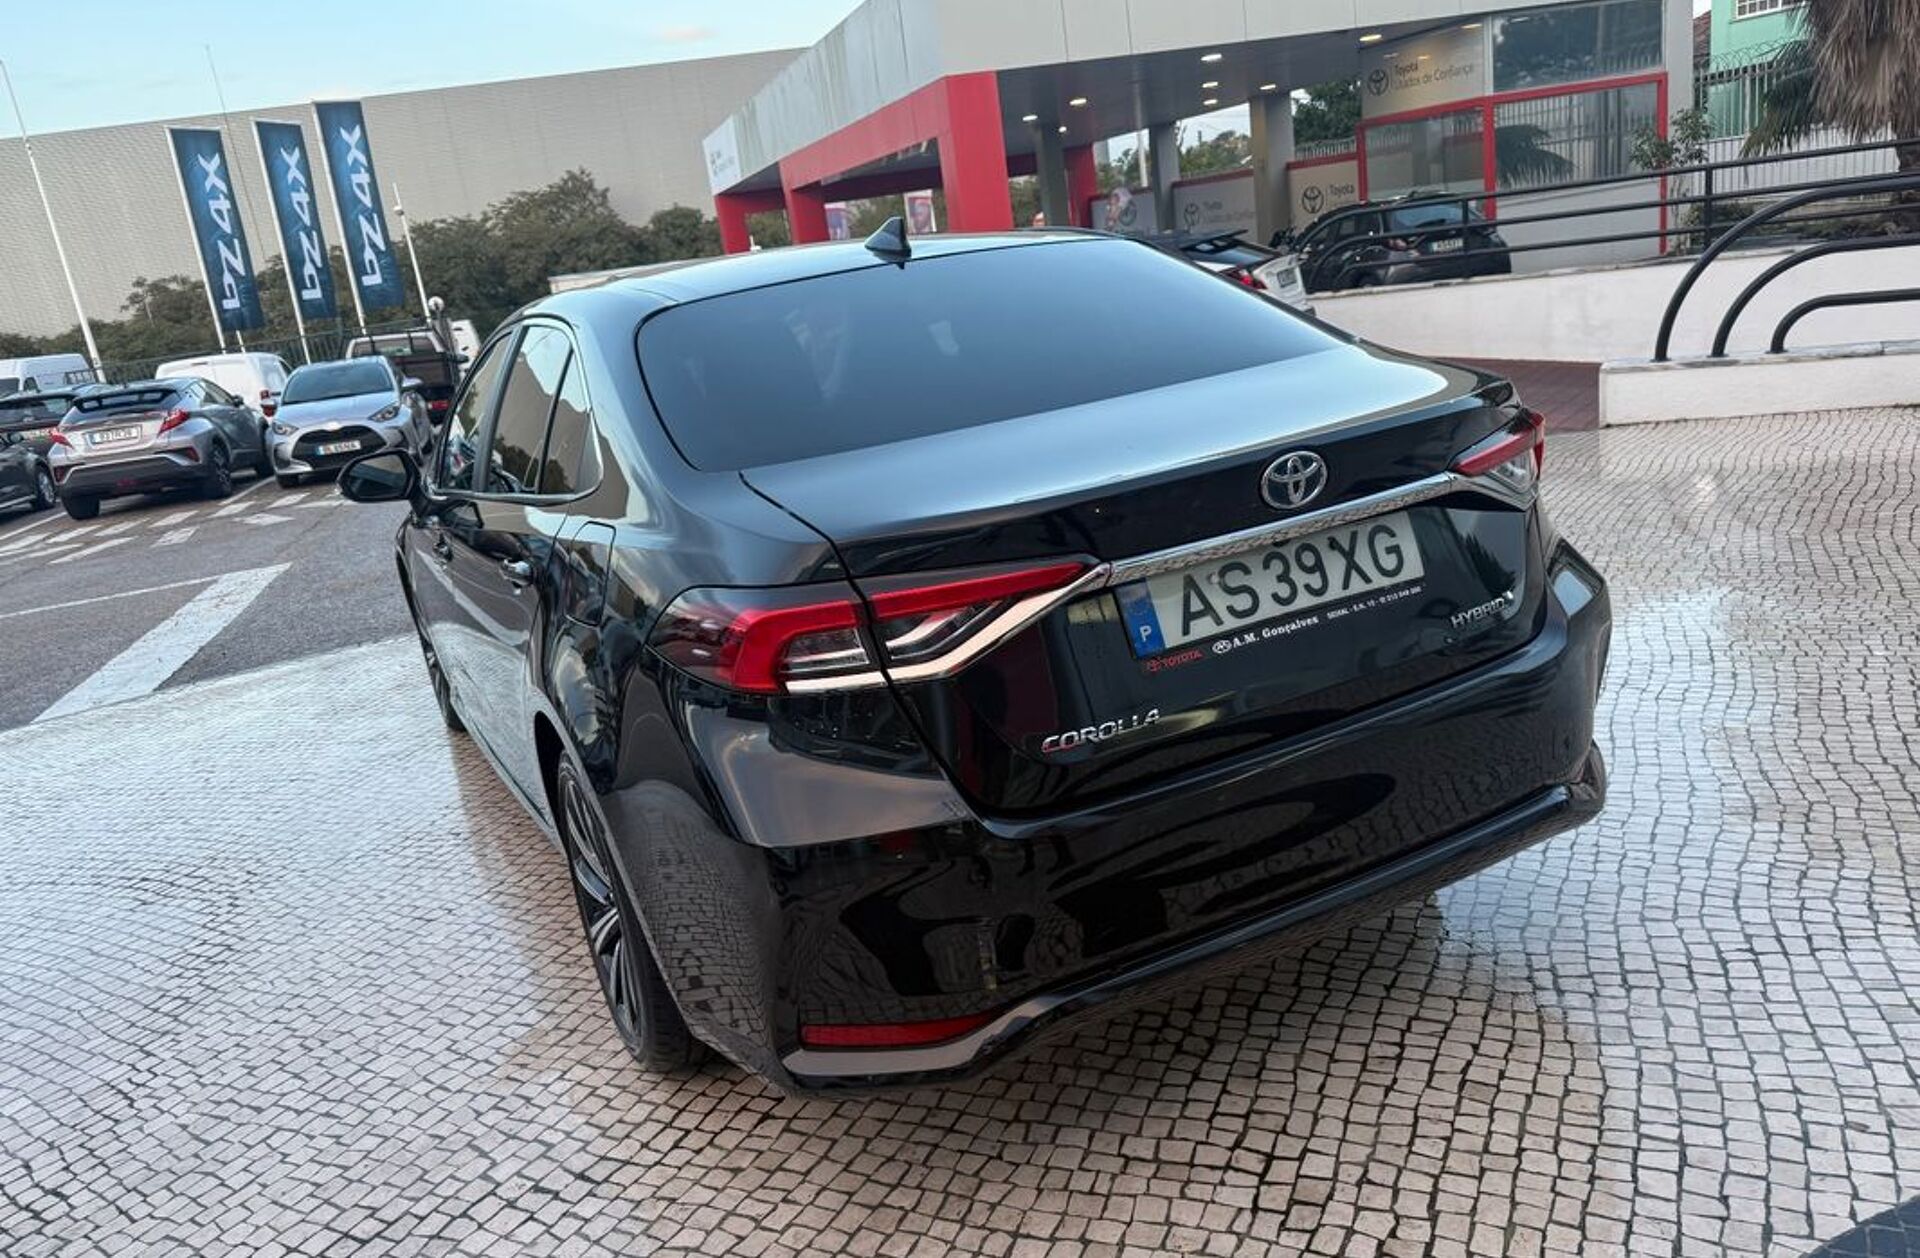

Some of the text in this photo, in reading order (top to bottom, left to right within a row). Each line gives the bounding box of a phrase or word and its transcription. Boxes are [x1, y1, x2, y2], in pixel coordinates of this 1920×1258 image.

[1261, 615, 1319, 638] Gonçalves
[1451, 597, 1505, 629] HYBRID
[1139, 625, 1152, 642] P
[1041, 707, 1159, 753] COROLLA
